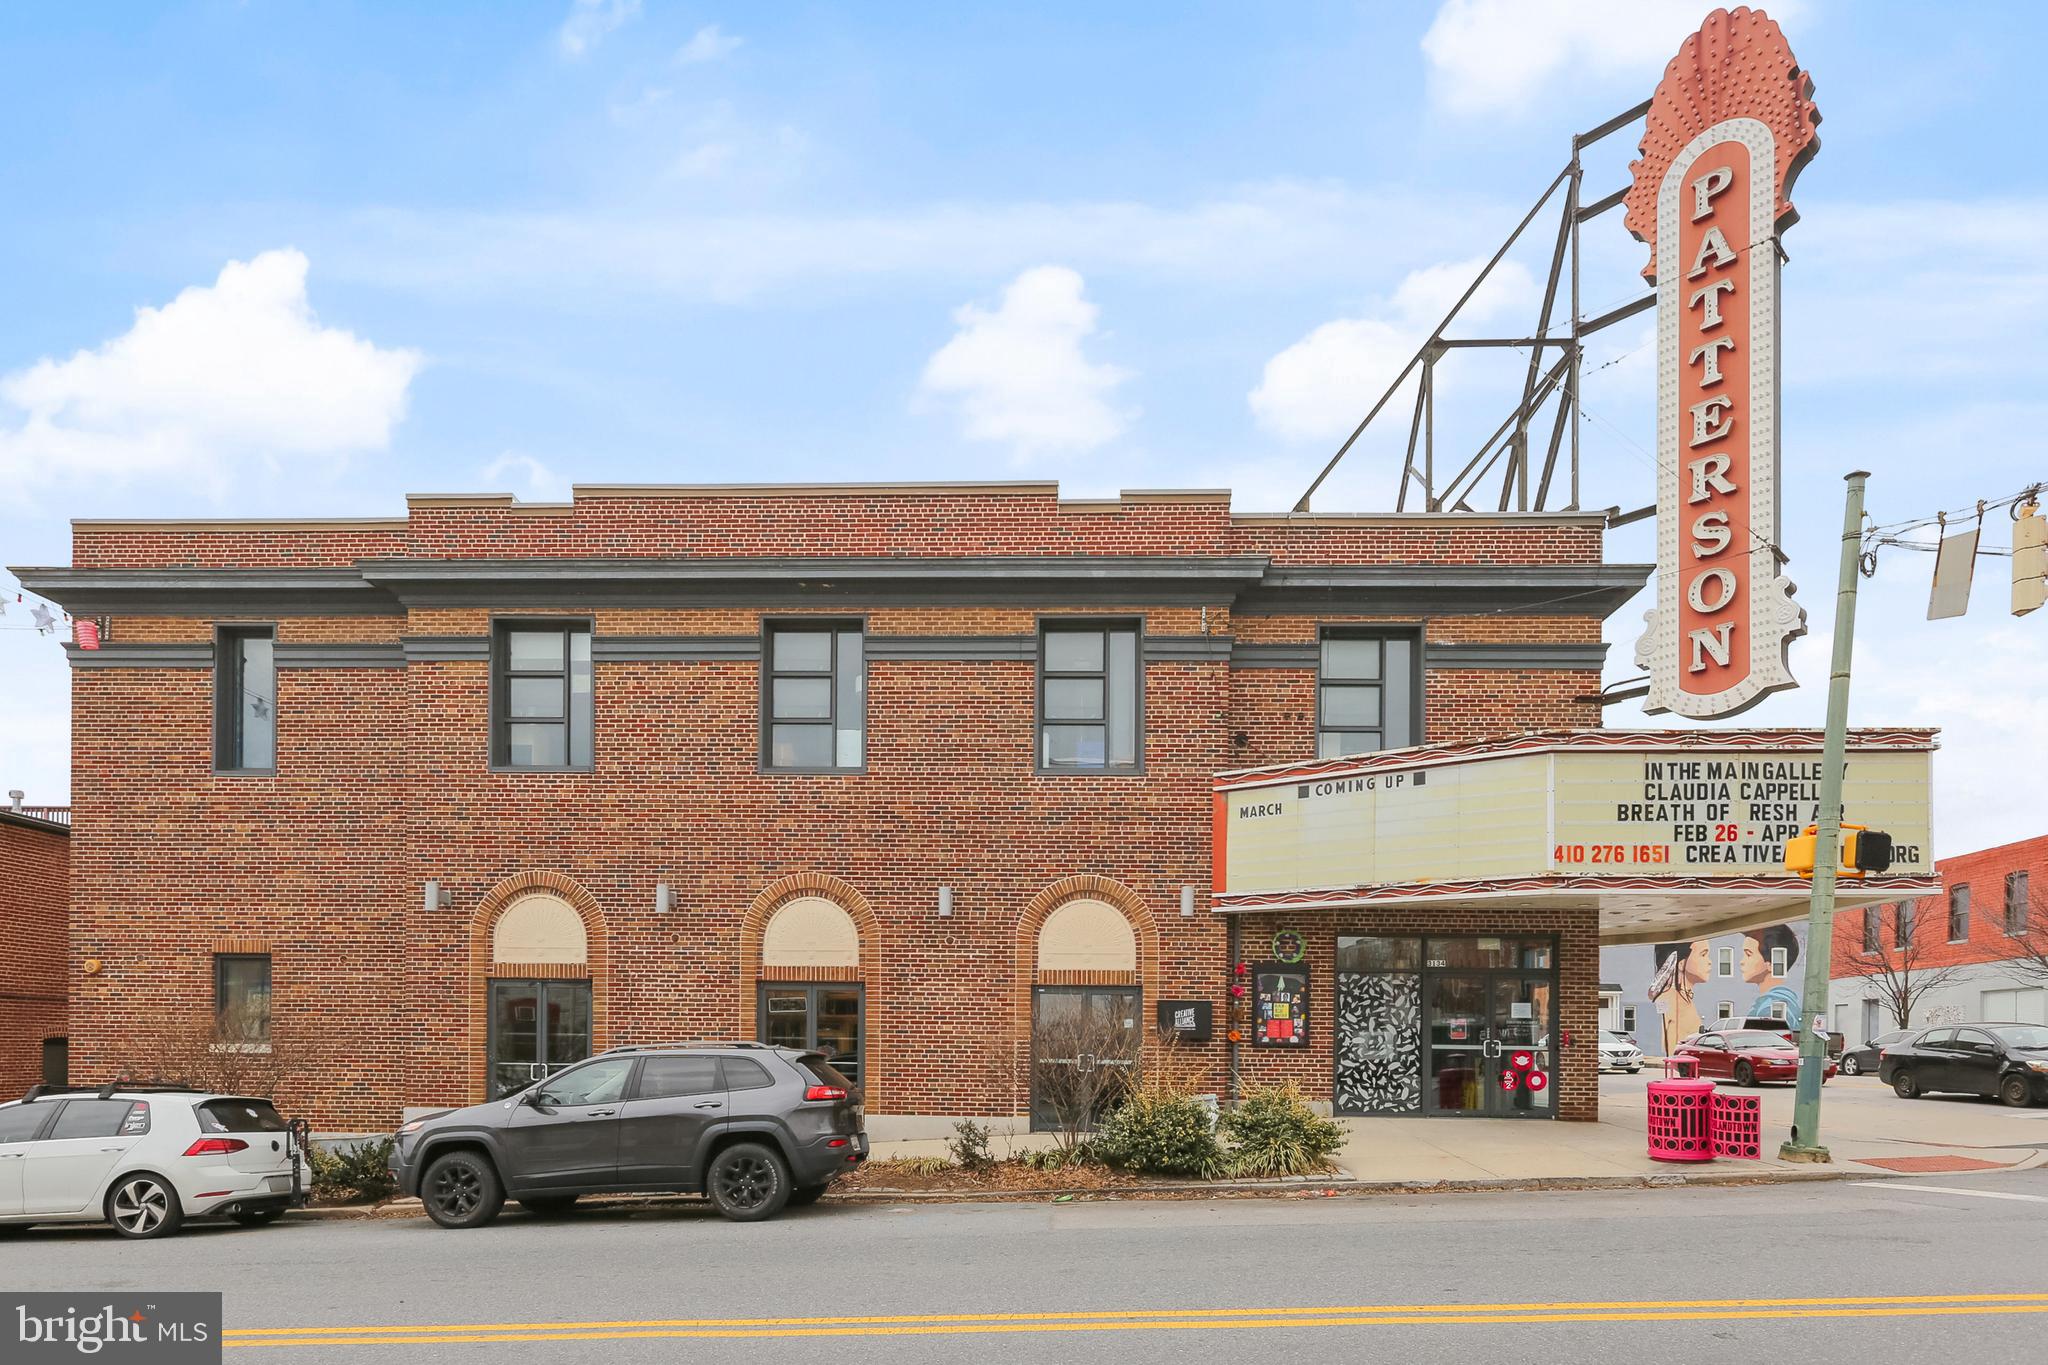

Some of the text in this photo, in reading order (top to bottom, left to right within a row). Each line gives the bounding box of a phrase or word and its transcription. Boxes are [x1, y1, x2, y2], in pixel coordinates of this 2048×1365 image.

[1686, 165, 1737, 673] PATTERSON
[1644, 762, 1663, 780] IN
[1667, 762, 1701, 780] THE
[1315, 774, 1404, 796] COMING UP
[1644, 783, 1731, 801] CLAUDIA
[1239, 803, 1282, 819] MARCH
[1617, 803, 1695, 822] BREATH
[1706, 803, 1729, 822] OF
[1750, 803, 1797, 822] RESH
[1673, 825, 1707, 842] FEB
[1715, 824, 1738, 842] 26
[1761, 824, 1799, 842] APR
[1554, 845, 1585, 863] 410
[1591, 845, 1625, 863] 276
[1633, 845, 1670, 863] 1651
[1713, 1120, 1757, 1132] LANDTOWN
